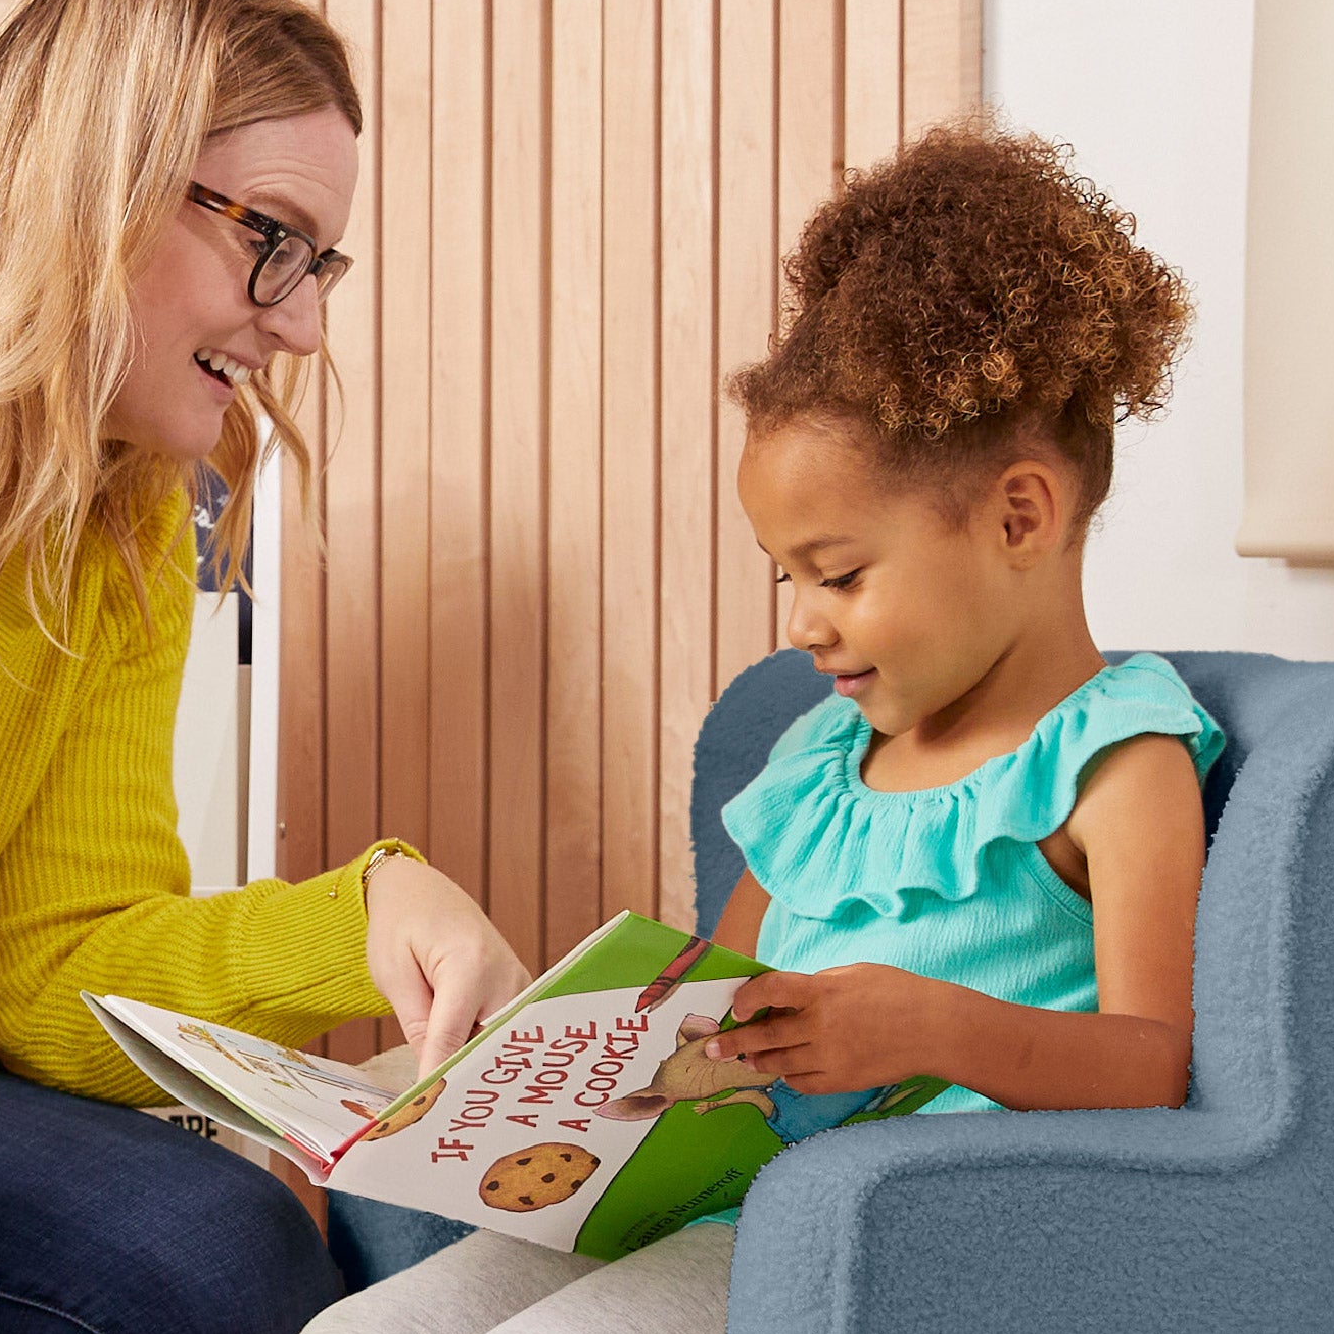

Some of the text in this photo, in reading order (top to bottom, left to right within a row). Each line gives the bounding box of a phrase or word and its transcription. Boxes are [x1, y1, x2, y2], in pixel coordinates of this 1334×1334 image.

[431, 1025, 545, 1164] IF YOU GIVE
[506, 1021, 597, 1128] A MOUSE
[558, 1014, 649, 1133] A COOKIE
[668, 1167, 745, 1218] Numeroff
